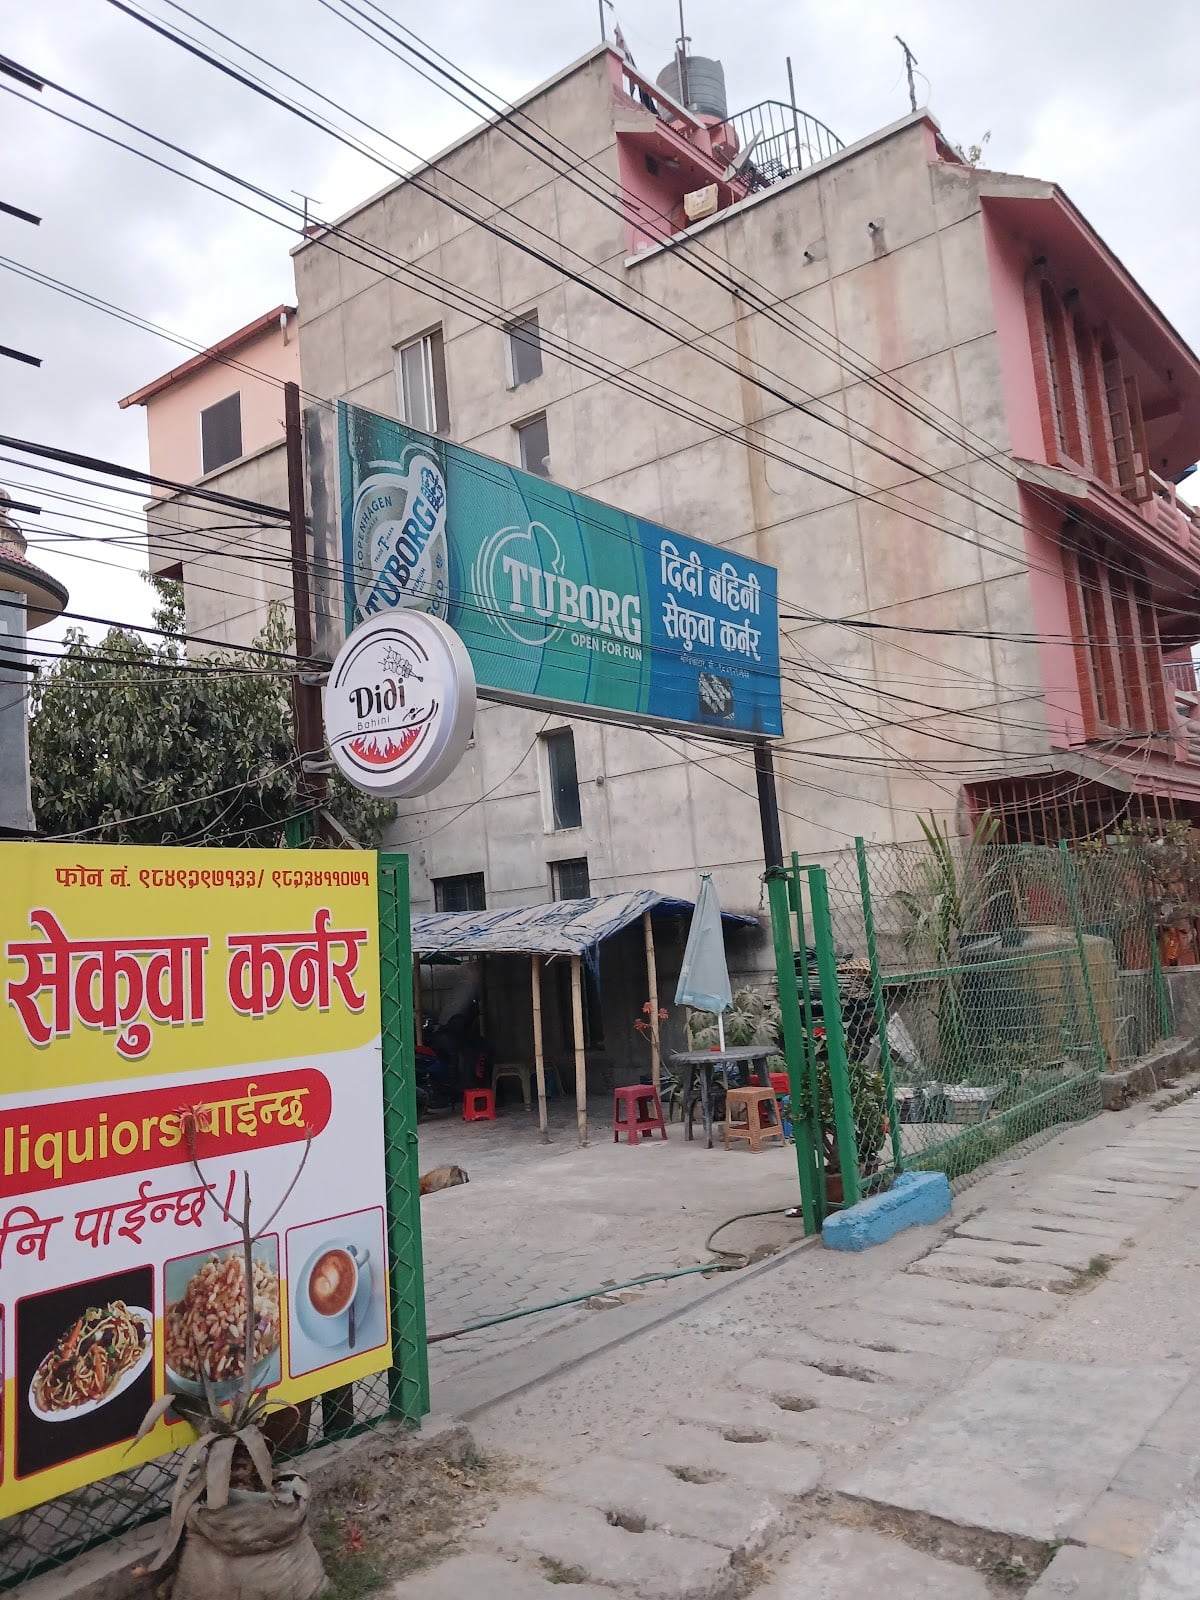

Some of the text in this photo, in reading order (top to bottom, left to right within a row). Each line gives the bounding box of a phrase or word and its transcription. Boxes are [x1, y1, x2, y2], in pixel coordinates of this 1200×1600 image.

[357, 495, 392, 571] COPENHAGEN
[364, 495, 437, 616] TUBORG
[502, 554, 642, 644] TUBORG
[660, 539, 761, 615] दिदी बहिनी
[570, 633, 643, 661] OPEN FOR FUN
[662, 592, 762, 661] सेकुवा कर्नर
[349, 677, 406, 719] Didi
[357, 716, 390, 731] Bahini
[55, 863, 105, 887] फोन
[272, 870, 370, 889] ९८२३४११०७१
[7, 907, 369, 1057] सेकुवा कर्नर
[4, 1112, 182, 1179] liquiors
